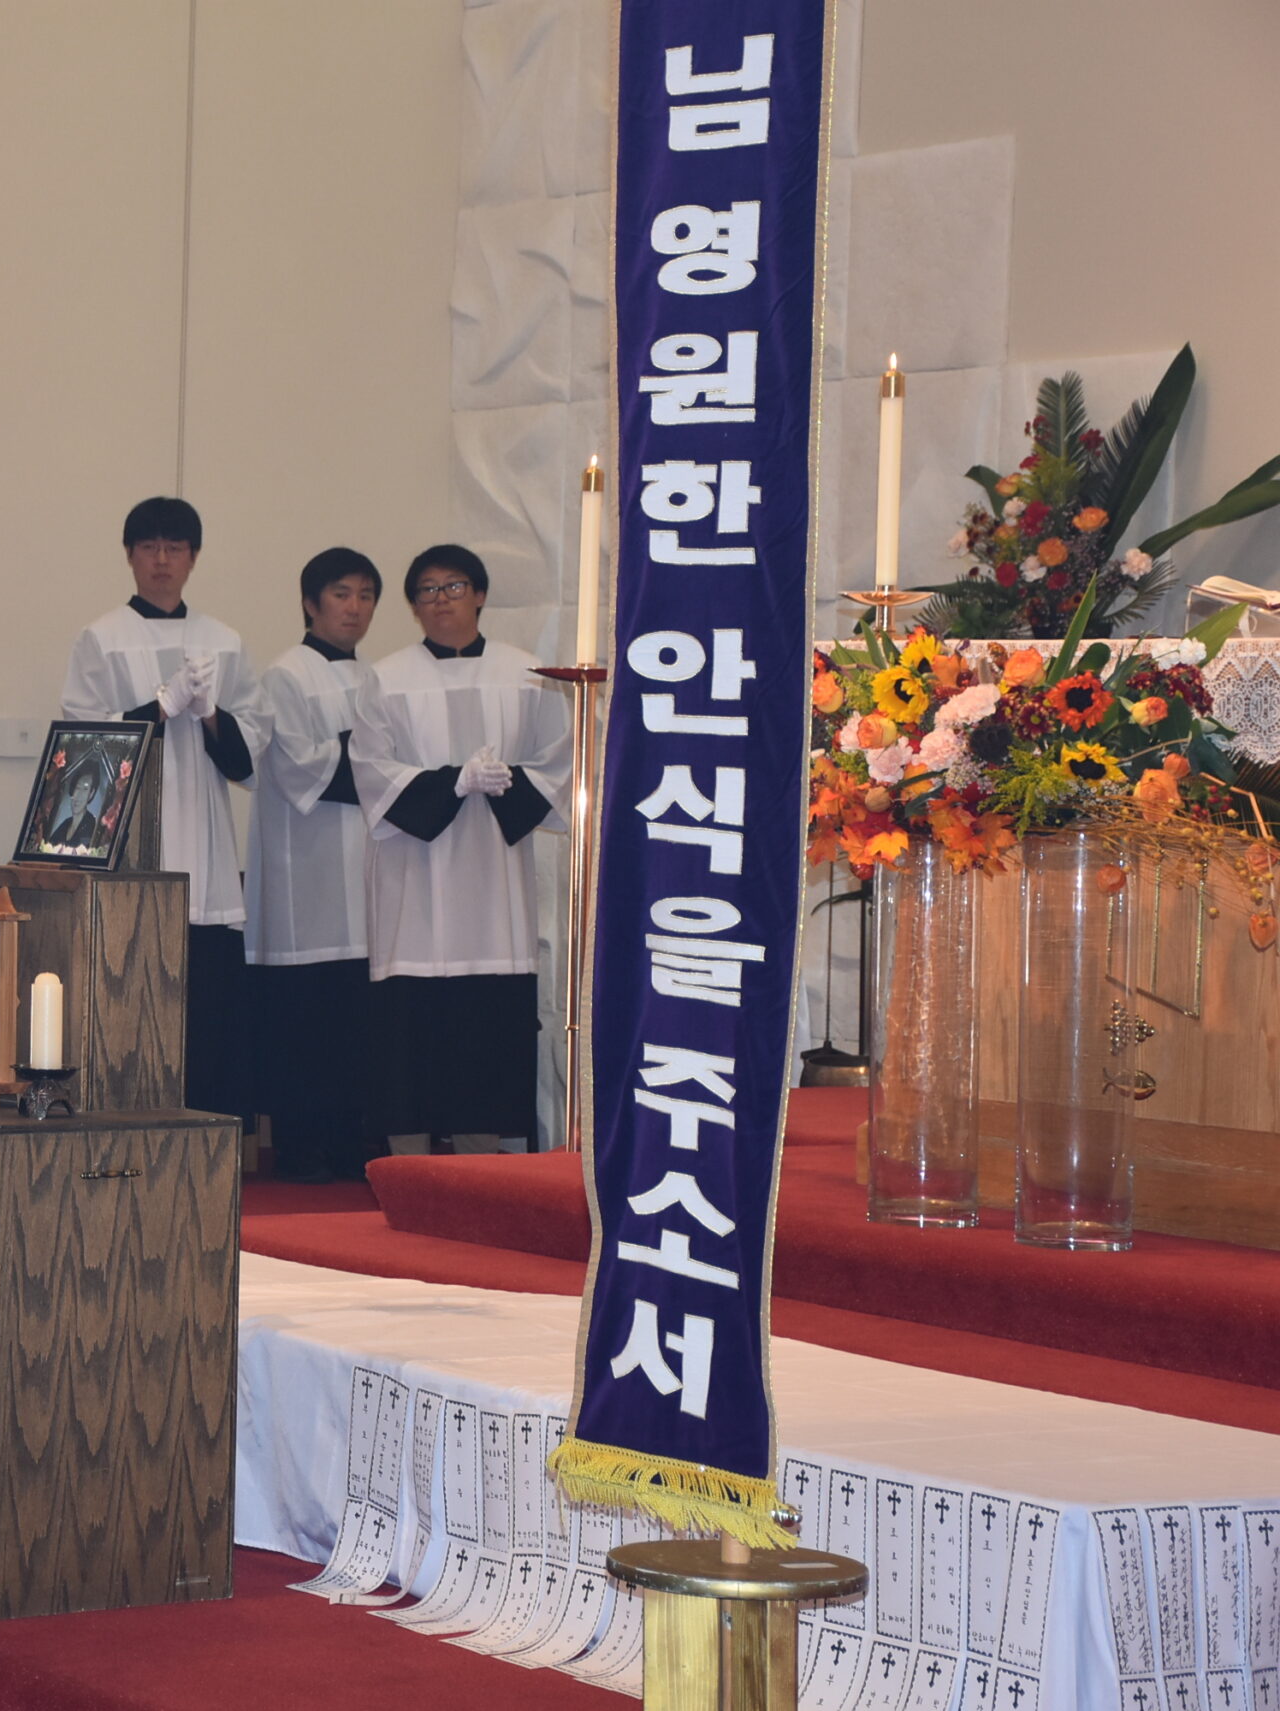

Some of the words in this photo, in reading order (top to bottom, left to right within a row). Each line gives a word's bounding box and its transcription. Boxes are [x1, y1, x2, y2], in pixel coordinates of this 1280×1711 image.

[638, 200, 762, 567] 영원한
[626, 628, 766, 1008] 안식을
[610, 1041, 739, 1420] 주소서
